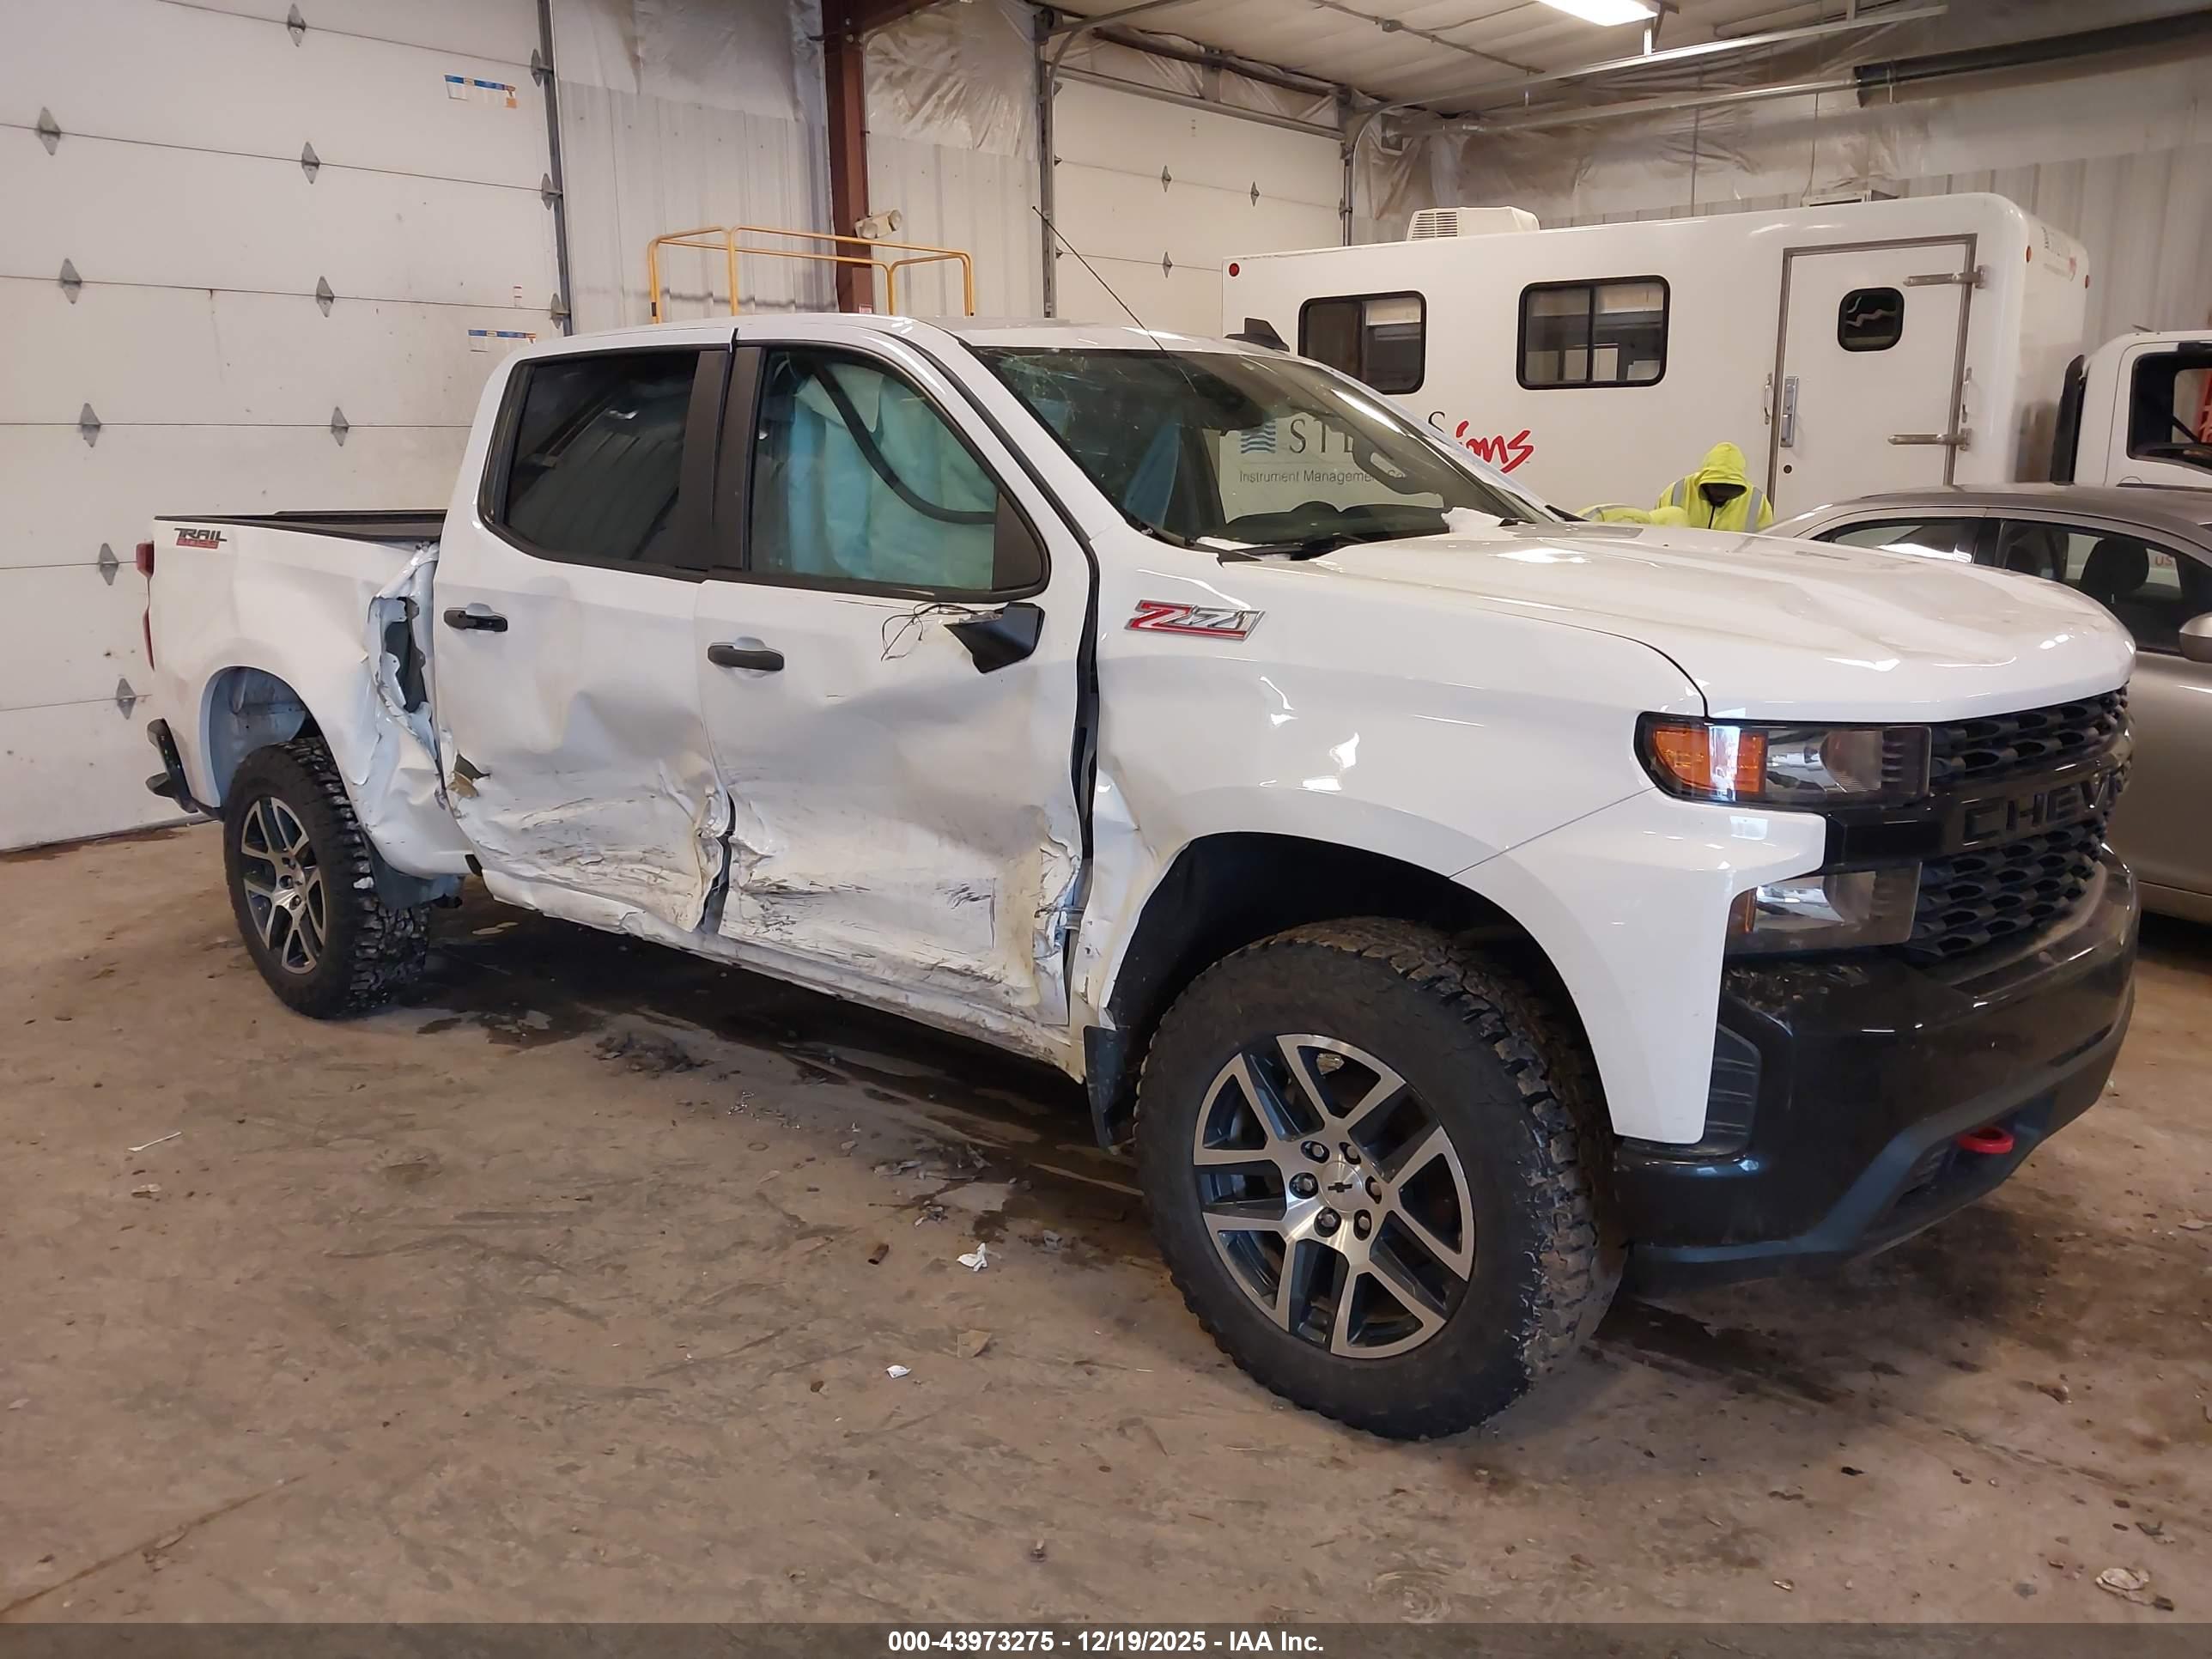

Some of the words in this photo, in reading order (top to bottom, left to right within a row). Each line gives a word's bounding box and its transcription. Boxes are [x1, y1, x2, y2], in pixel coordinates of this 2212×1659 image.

[1239, 470, 1299, 483] Instrument
[173, 527, 228, 542] TRAIL
[1124, 599, 1266, 644] Z71
